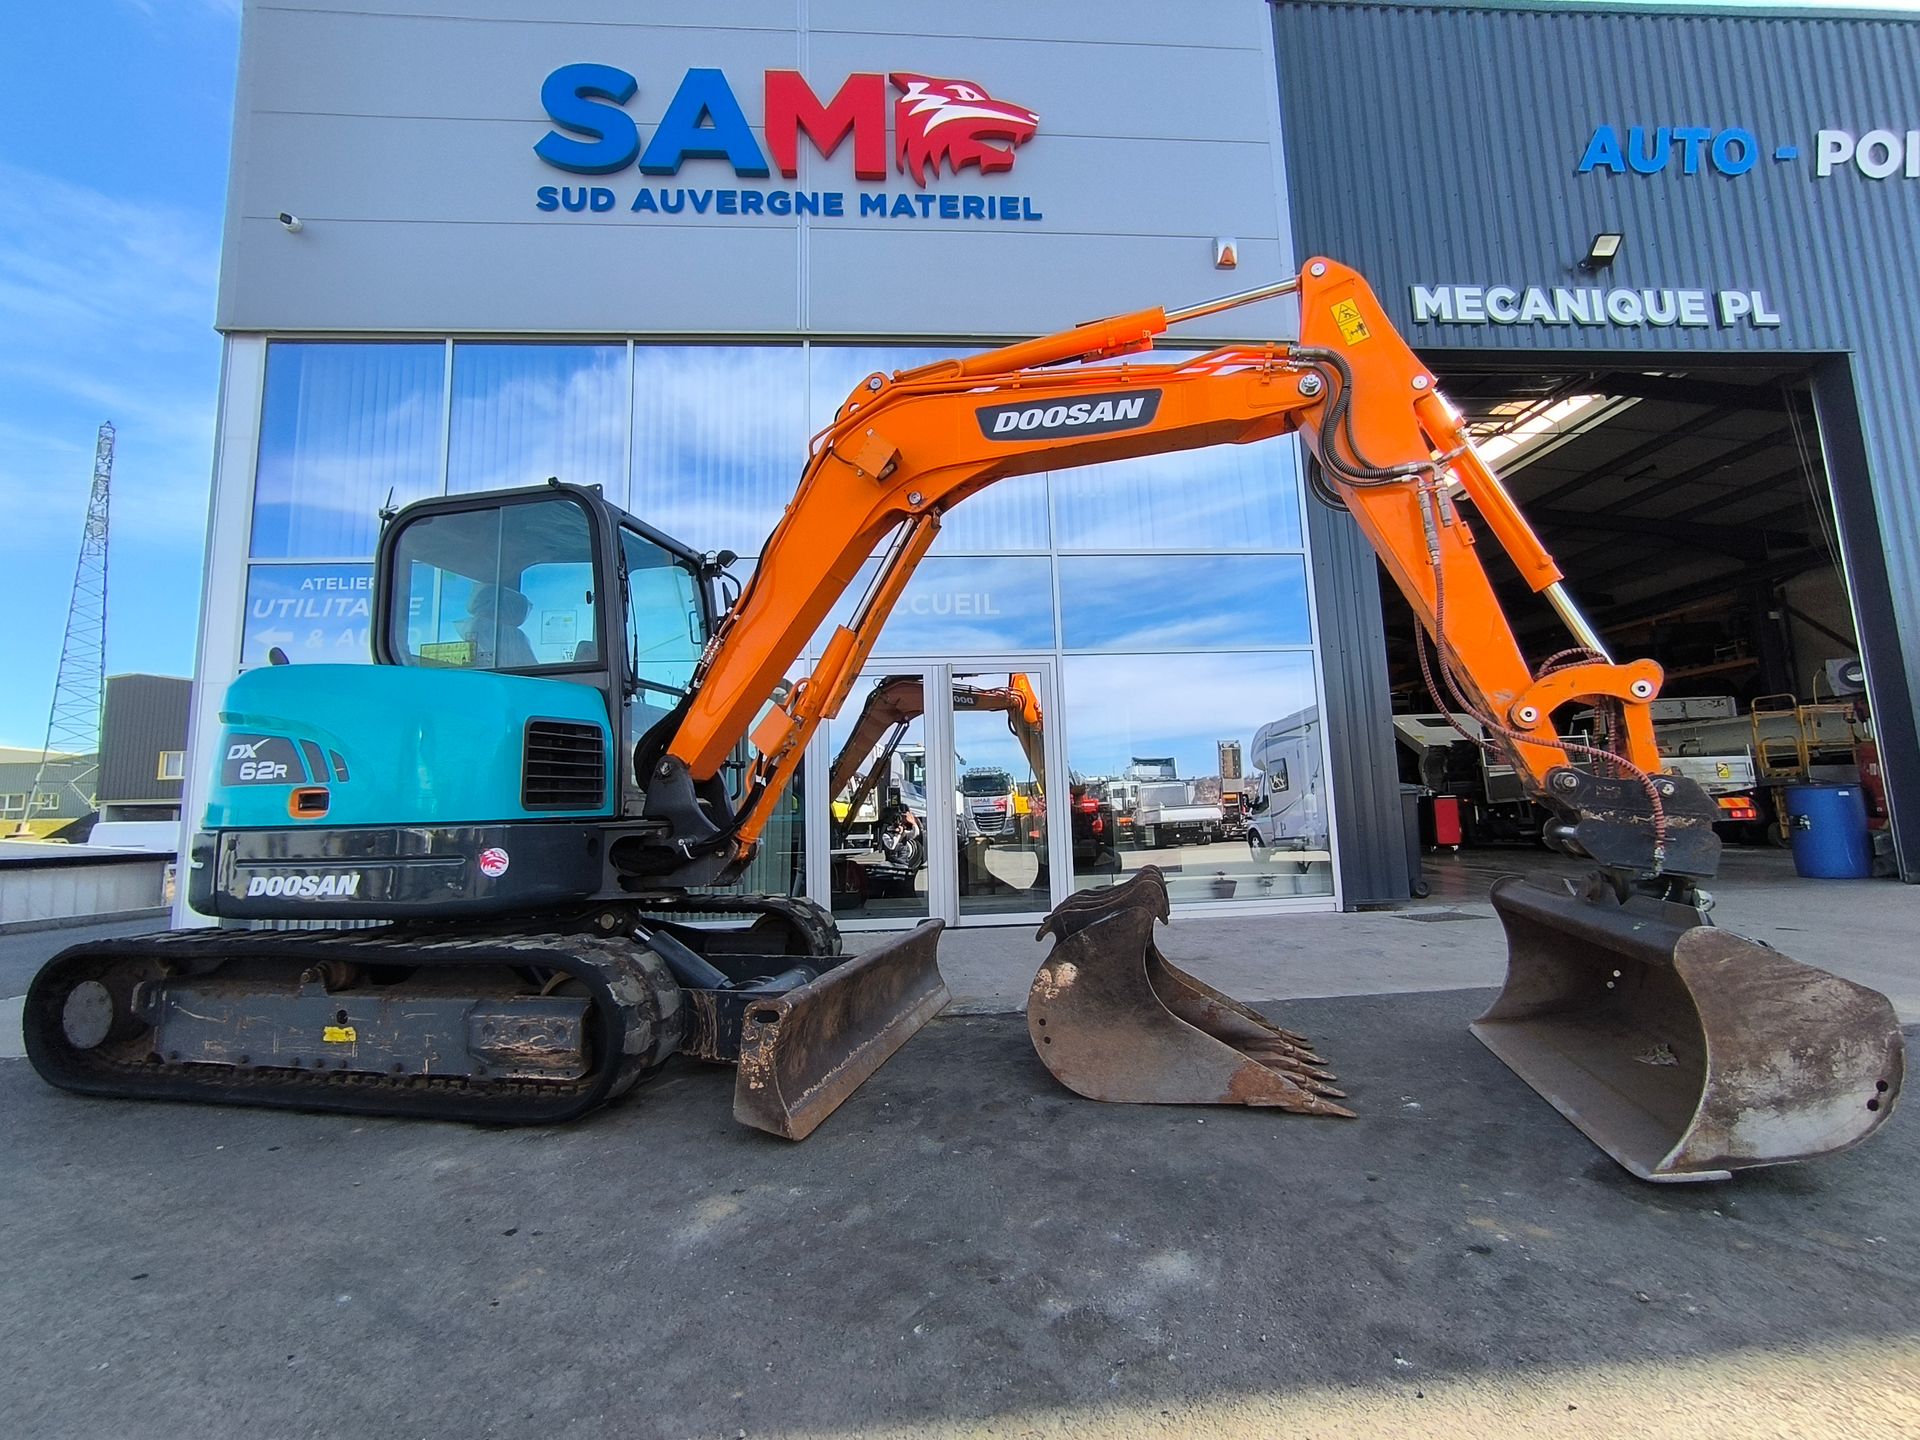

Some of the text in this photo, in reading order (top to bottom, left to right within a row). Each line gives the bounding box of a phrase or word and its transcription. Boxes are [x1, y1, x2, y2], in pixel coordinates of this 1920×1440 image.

[533, 63, 887, 180] SAM
[1578, 124, 1759, 176] AUTO
[536, 186, 1043, 220] SUD AUVERGNE MATERIEL
[1411, 285, 1781, 327] MECANIQUE PL
[993, 397, 1145, 433] DOOSAN
[304, 628, 324, 649] &
[227, 738, 271, 760] DX
[239, 761, 288, 780] 62R
[247, 874, 361, 897] DOOSAN
